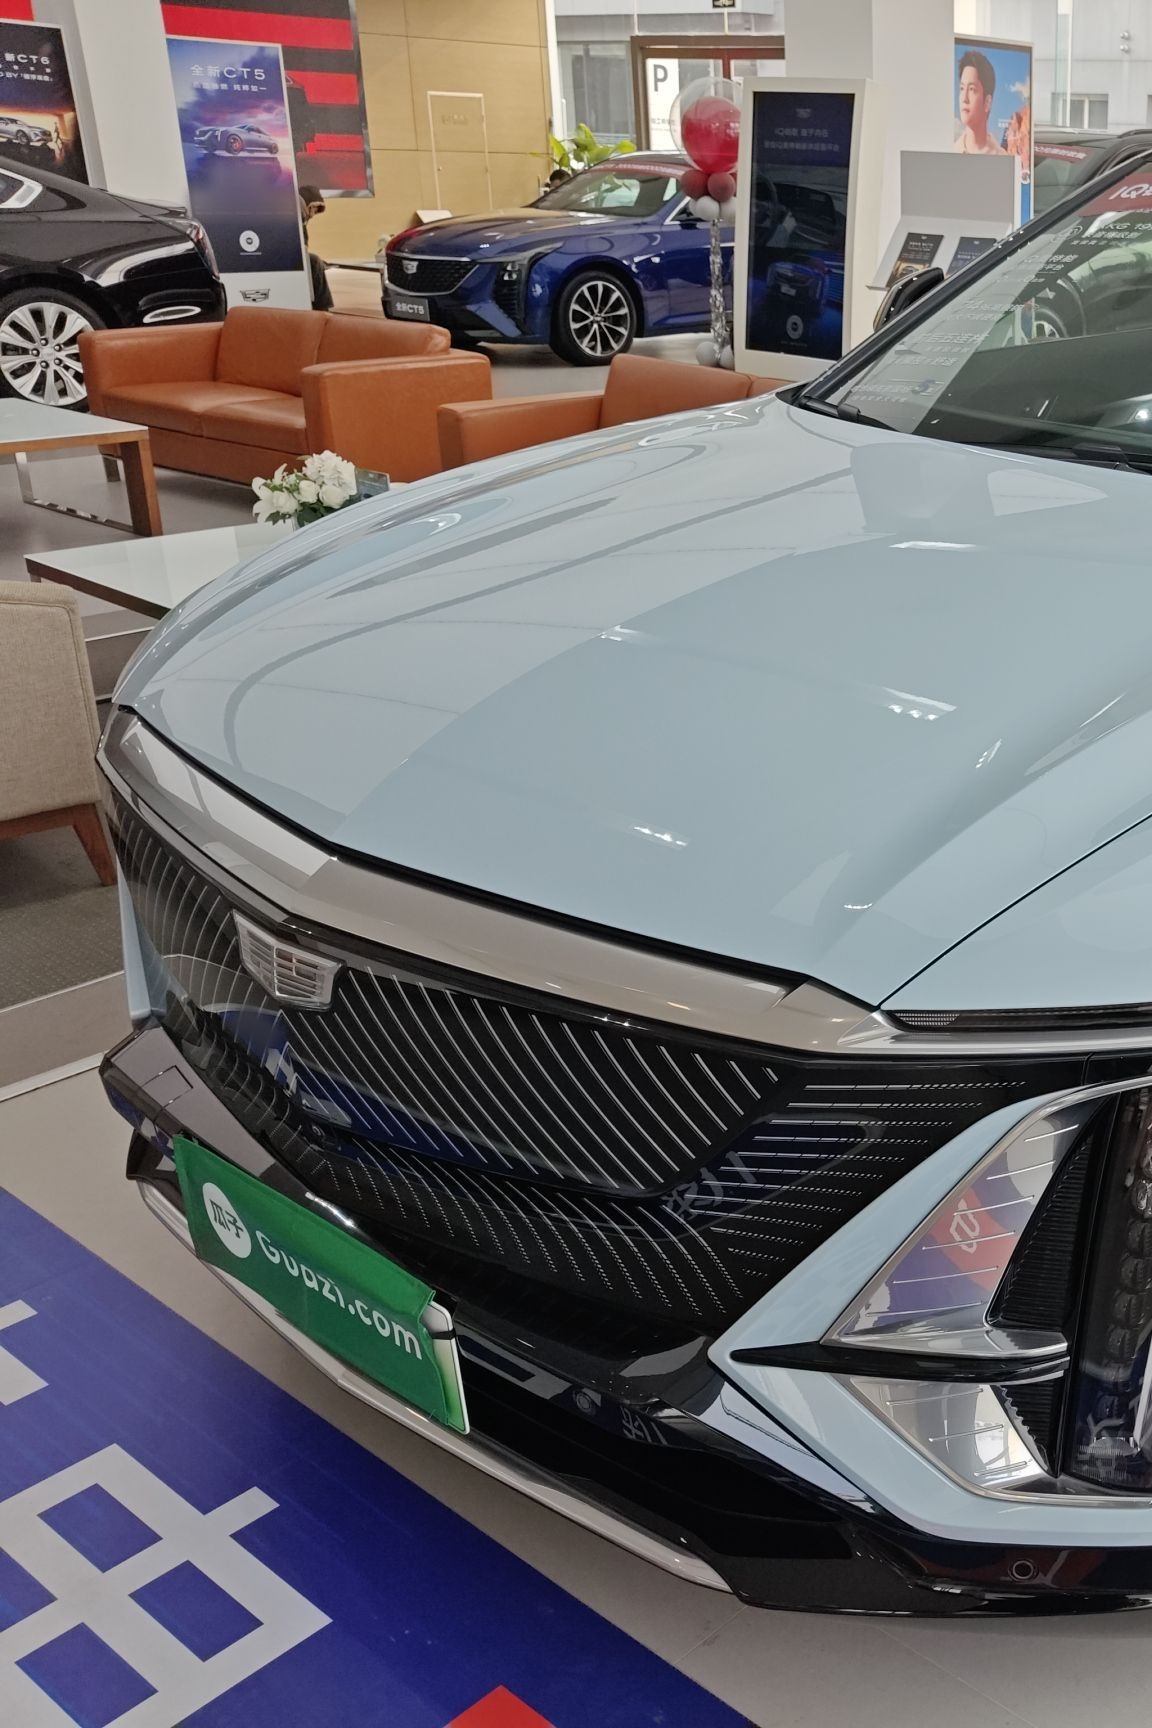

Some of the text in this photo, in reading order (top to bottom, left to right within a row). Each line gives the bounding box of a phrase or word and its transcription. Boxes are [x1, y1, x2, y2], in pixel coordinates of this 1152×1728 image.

[190, 64, 266, 81] 全新CT5
[653, 64, 668, 92] P
[210, 1200, 244, 1239] 瓜子
[255, 1230, 423, 1360] Guazi.com
